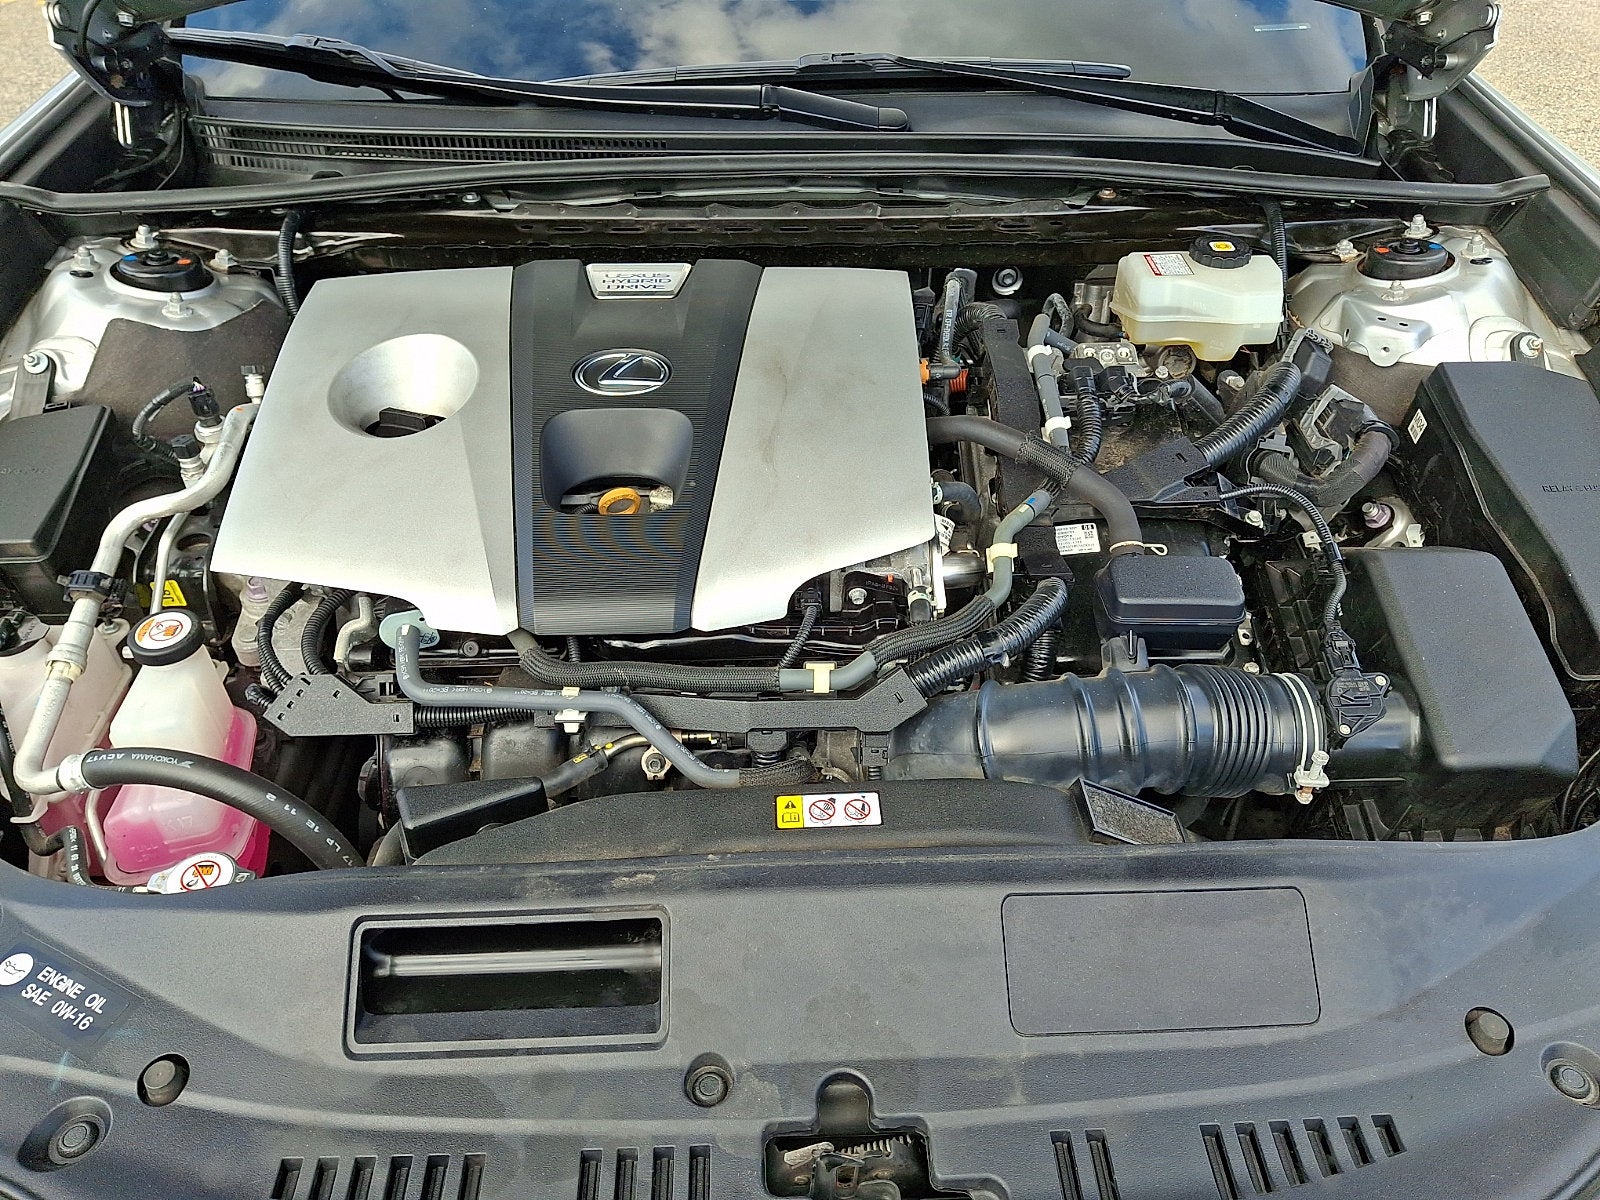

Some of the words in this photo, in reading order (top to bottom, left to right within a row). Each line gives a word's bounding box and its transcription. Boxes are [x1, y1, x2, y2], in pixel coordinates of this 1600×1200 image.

[86, 753, 126, 763] ACV17
[131, 753, 178, 765] YOKOHAMA
[265, 792, 277, 802] 2
[283, 804, 297, 816] 11
[326, 837, 341, 853] LP
[36, 965, 86, 1000] ENGINE
[84, 993, 107, 1014] OIL
[21, 983, 52, 1006] SAE
[50, 1000, 94, 1031] 0W-16
